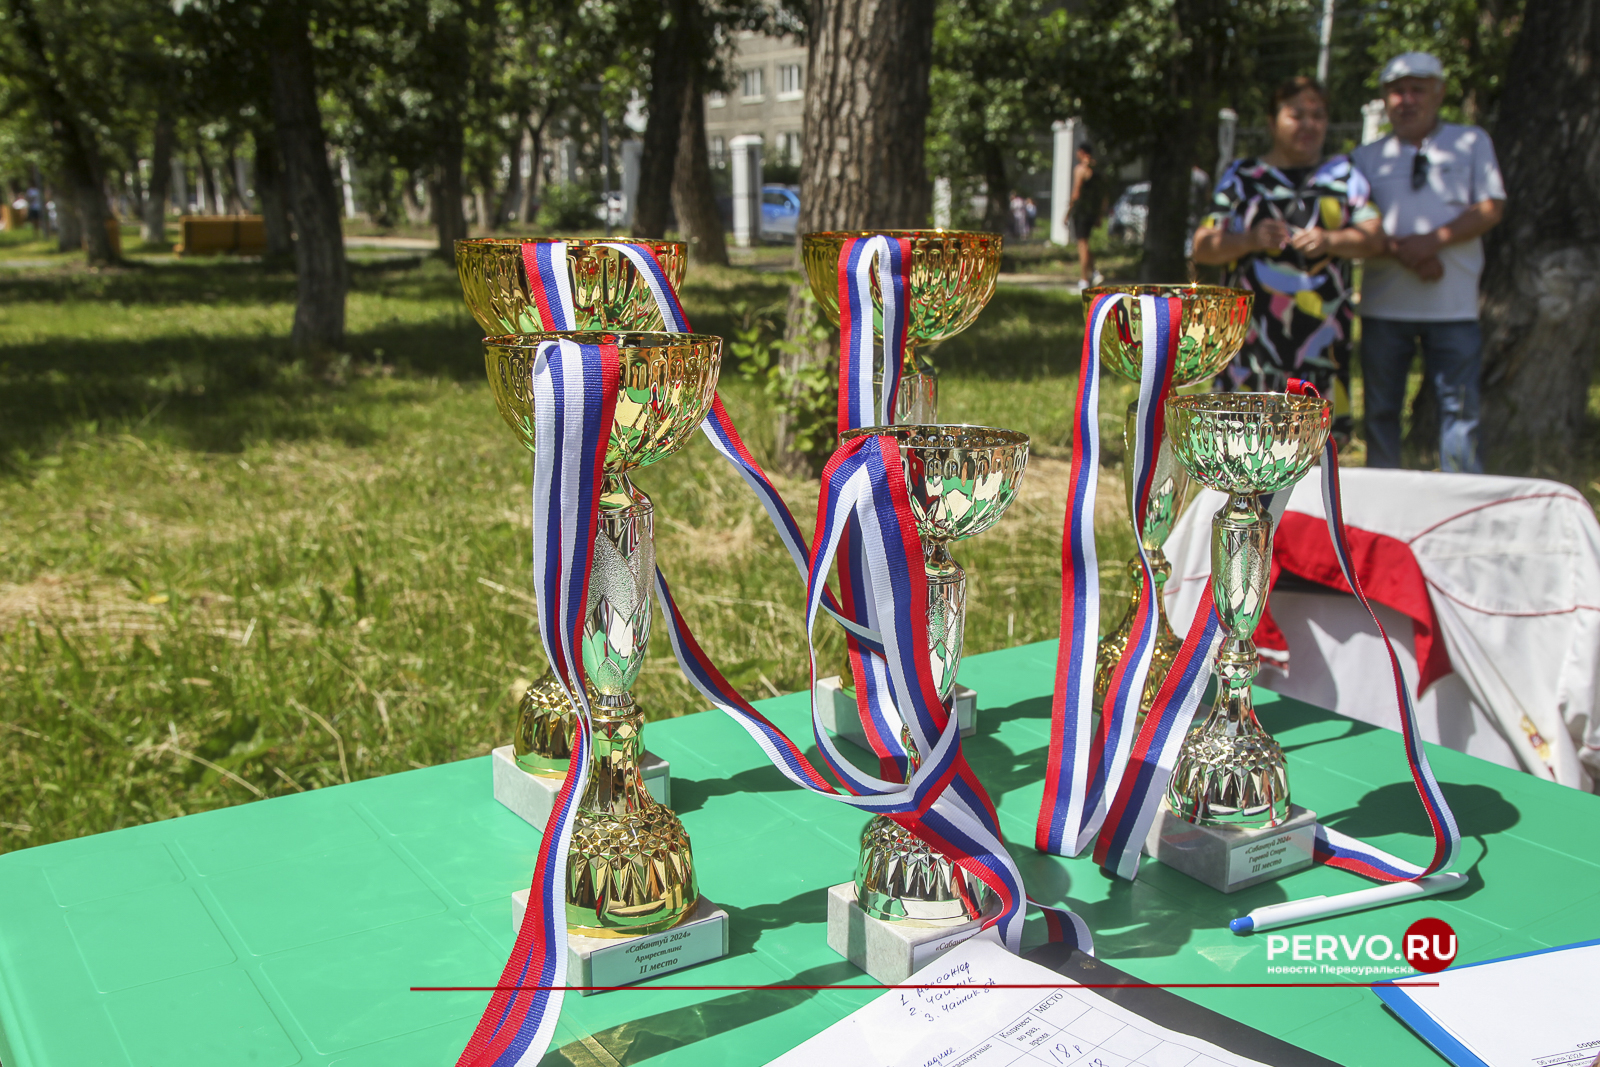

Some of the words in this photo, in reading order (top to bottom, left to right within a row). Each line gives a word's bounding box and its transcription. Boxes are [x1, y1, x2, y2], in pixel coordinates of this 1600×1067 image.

[1261, 858, 1282, 870] место
[625, 935, 669, 954] «Сабантуй
[669, 931, 691, 943] 2024»
[634, 944, 683, 963] Армрестлинг
[639, 965, 647, 975] II
[649, 957, 678, 972] место
[1034, 993, 1063, 1013] МЕСТО
[999, 1016, 1032, 1039] Количест
[1016, 1033, 1027, 1041] во
[1029, 1032, 1050, 1046] время
